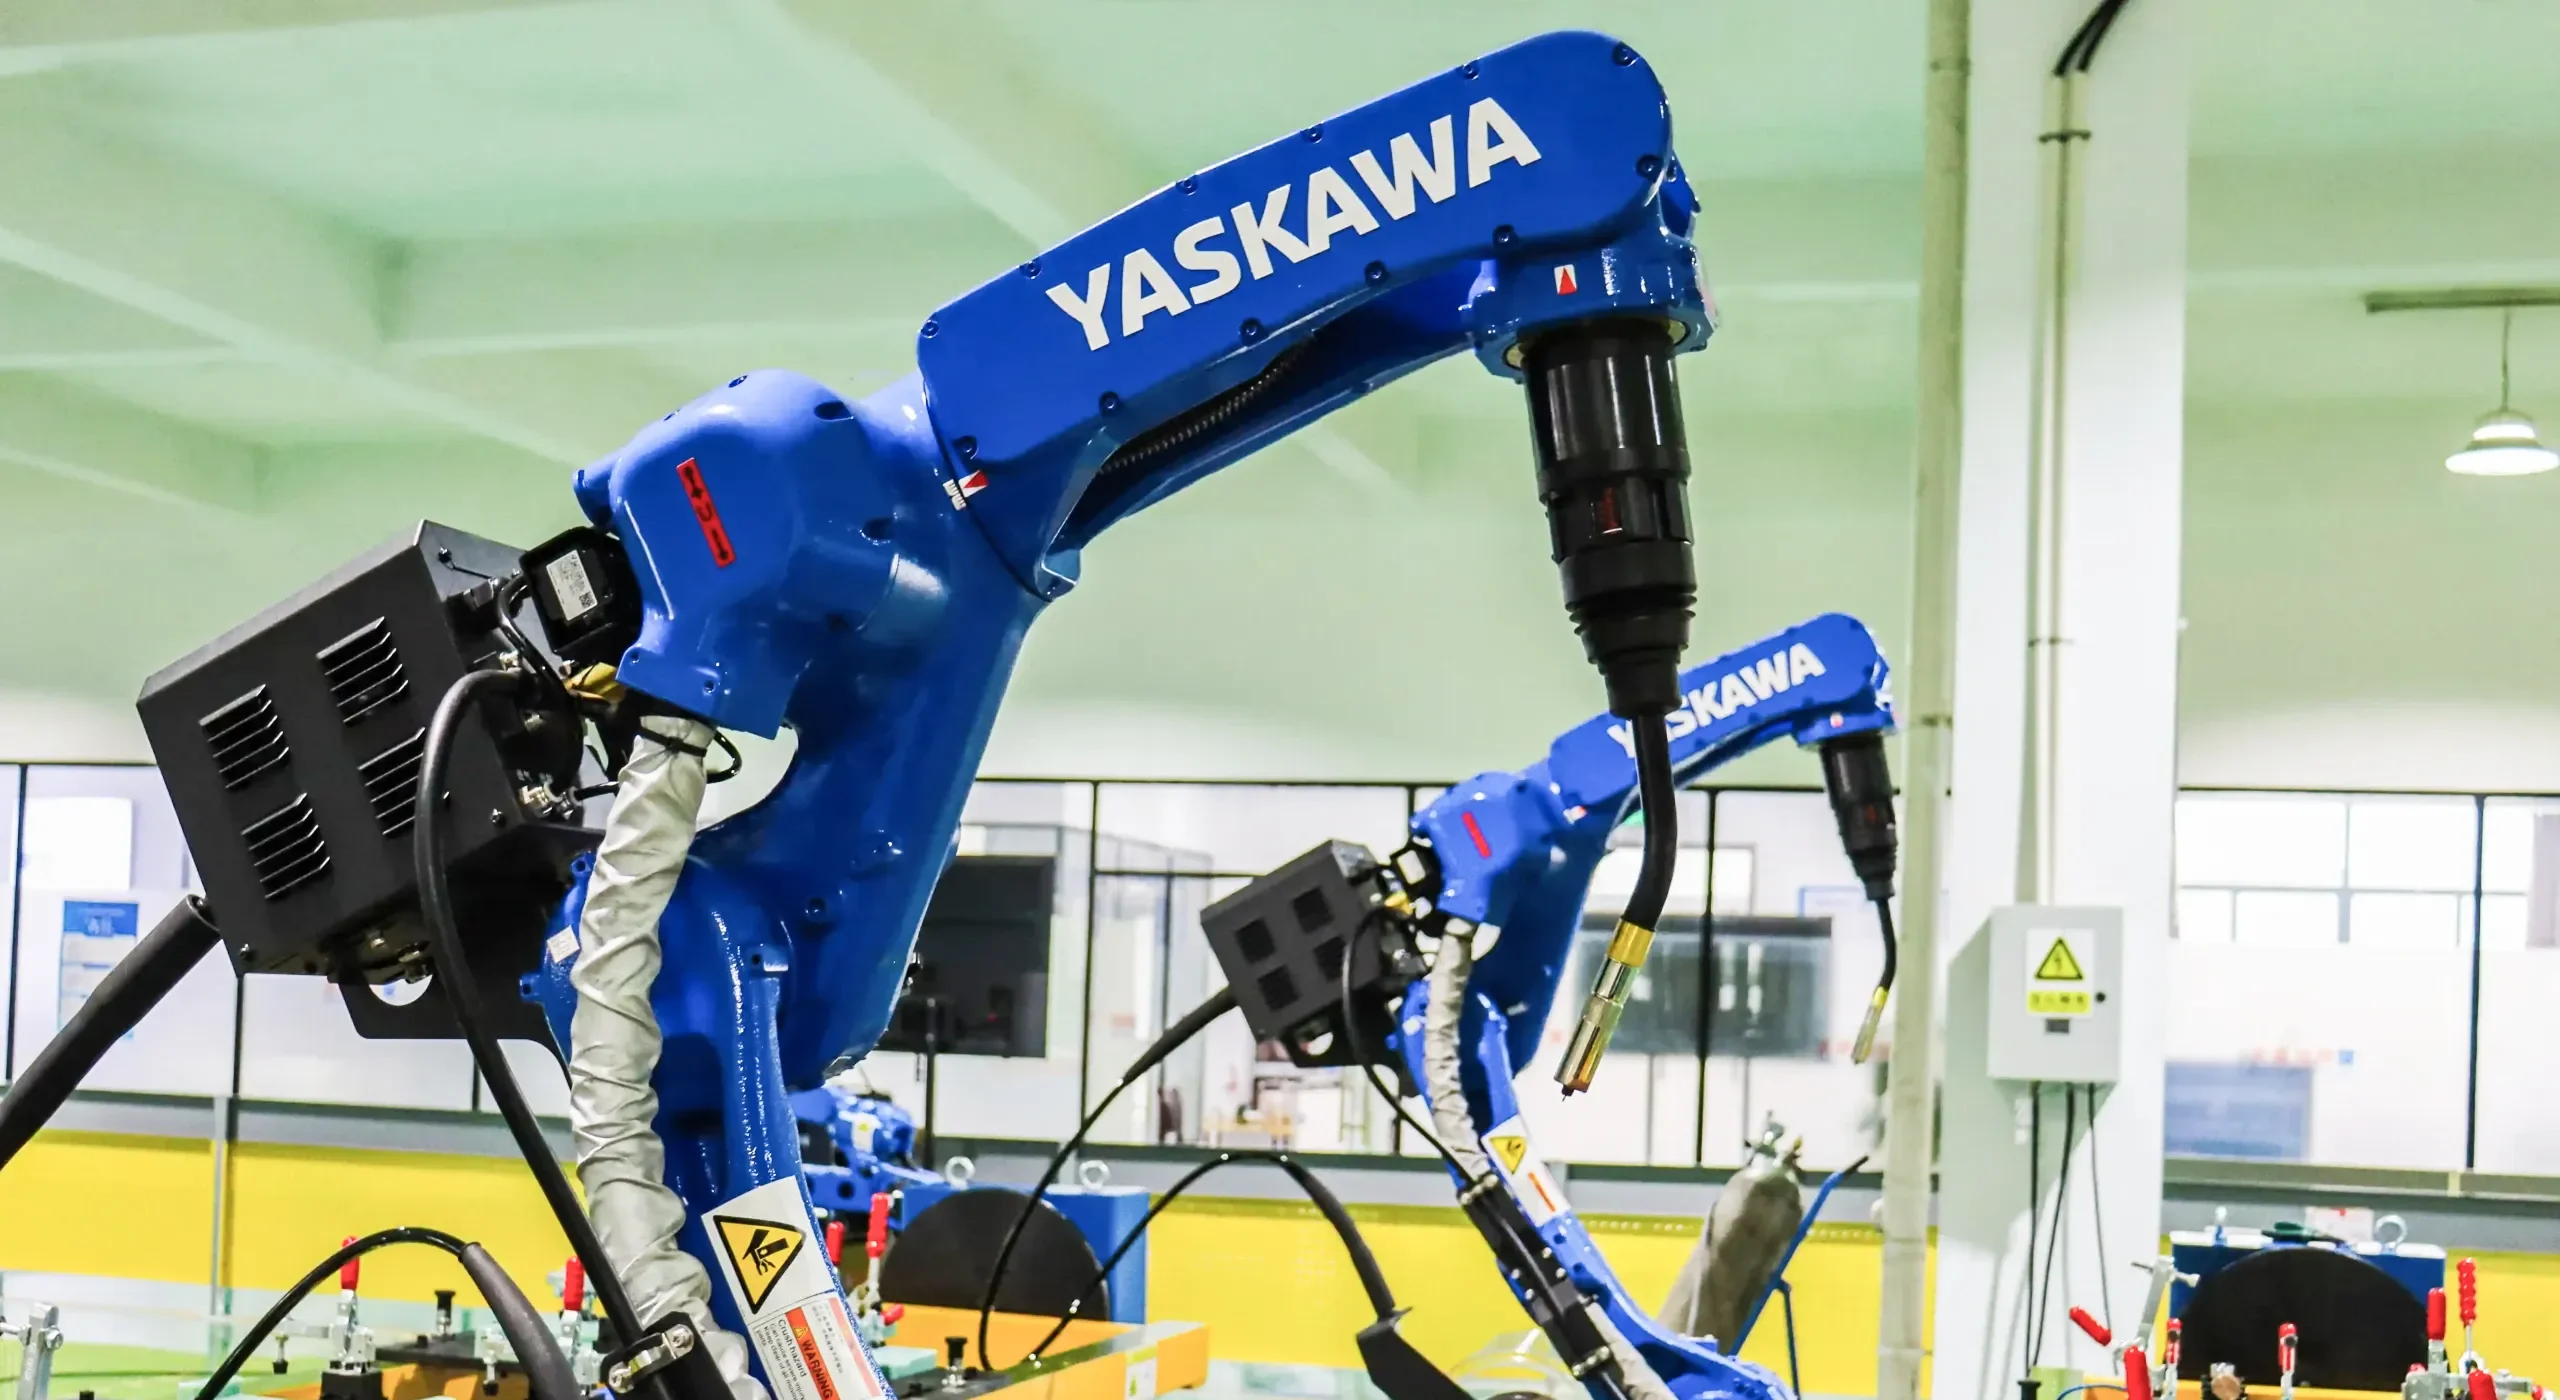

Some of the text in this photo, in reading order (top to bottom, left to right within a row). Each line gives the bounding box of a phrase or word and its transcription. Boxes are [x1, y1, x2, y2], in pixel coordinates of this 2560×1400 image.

[1046, 97, 1542, 351] YASKAWA
[1607, 642, 1826, 759] YSKAWA
[764, 1325, 774, 1345] Keep
[771, 1344, 781, 1361] clear
[786, 1379, 798, 1400] movin
[770, 1323, 779, 1338] Can
[785, 1359, 797, 1381] severe
[778, 1319, 808, 1377] Crush hazard
[802, 1339, 833, 1400] WARNING
